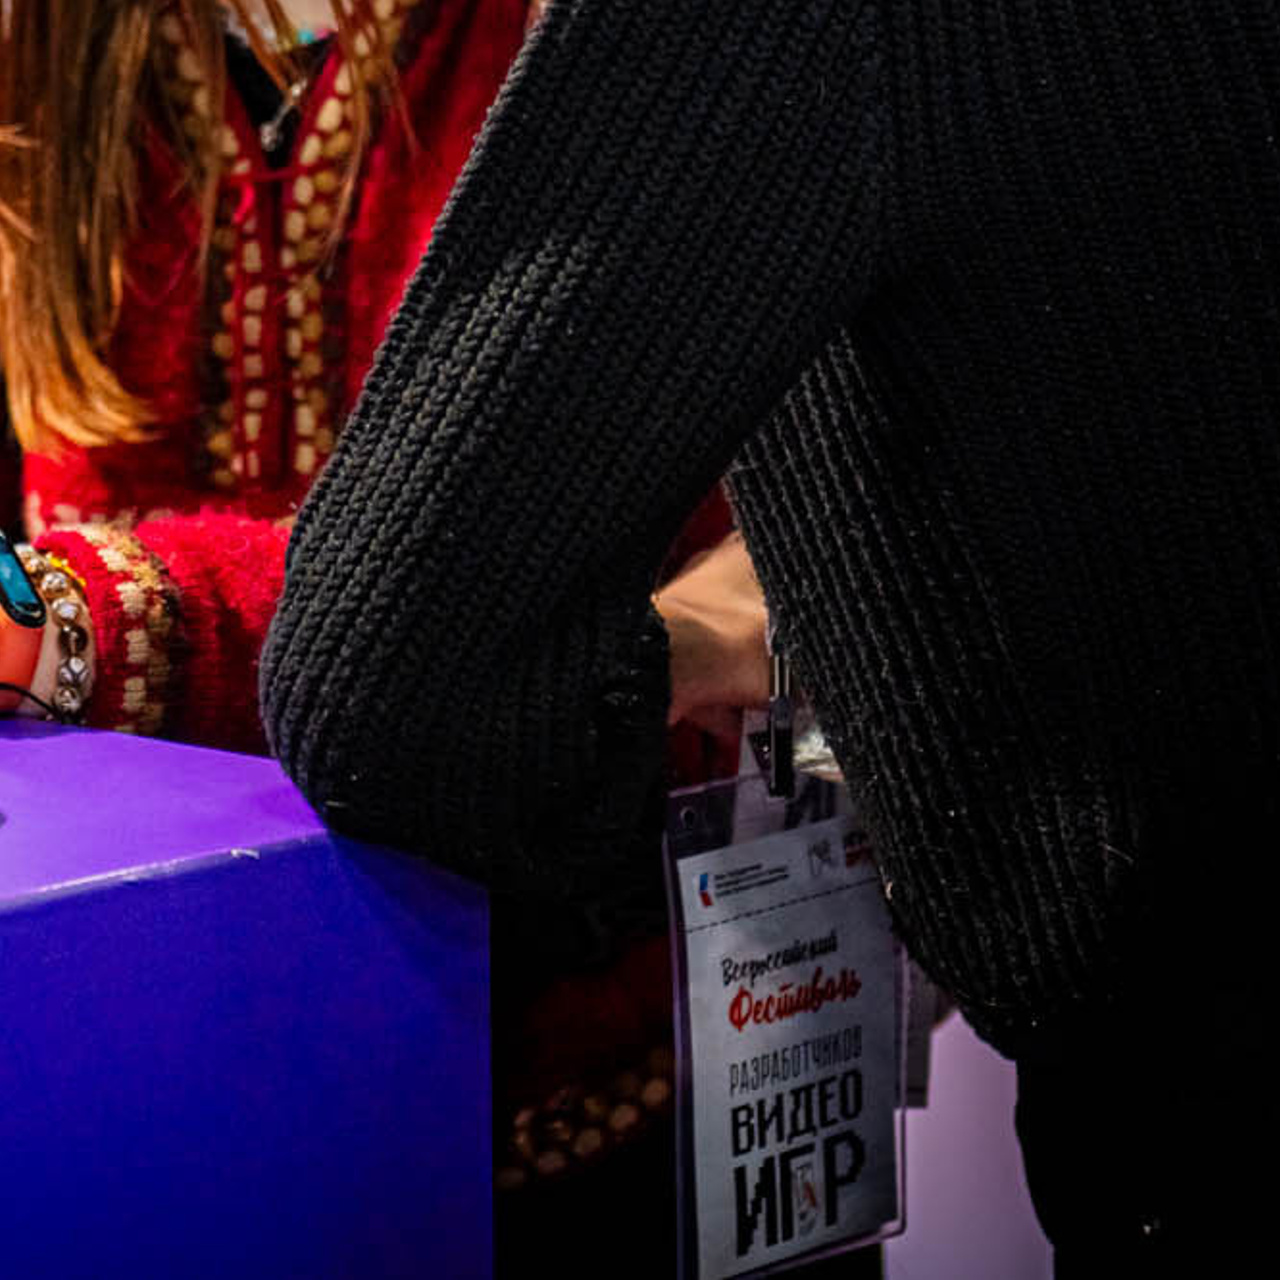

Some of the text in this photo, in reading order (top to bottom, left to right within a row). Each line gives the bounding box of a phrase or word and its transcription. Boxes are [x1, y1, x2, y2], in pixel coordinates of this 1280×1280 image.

[722, 929, 838, 986] Всероссийский
[729, 966, 862, 1034] Фестиваль
[730, 1024, 863, 1098] РАЗРАБОТЧИКОВ
[731, 1068, 863, 1158] ВИДЕО
[733, 1128, 866, 1259] ИГР
